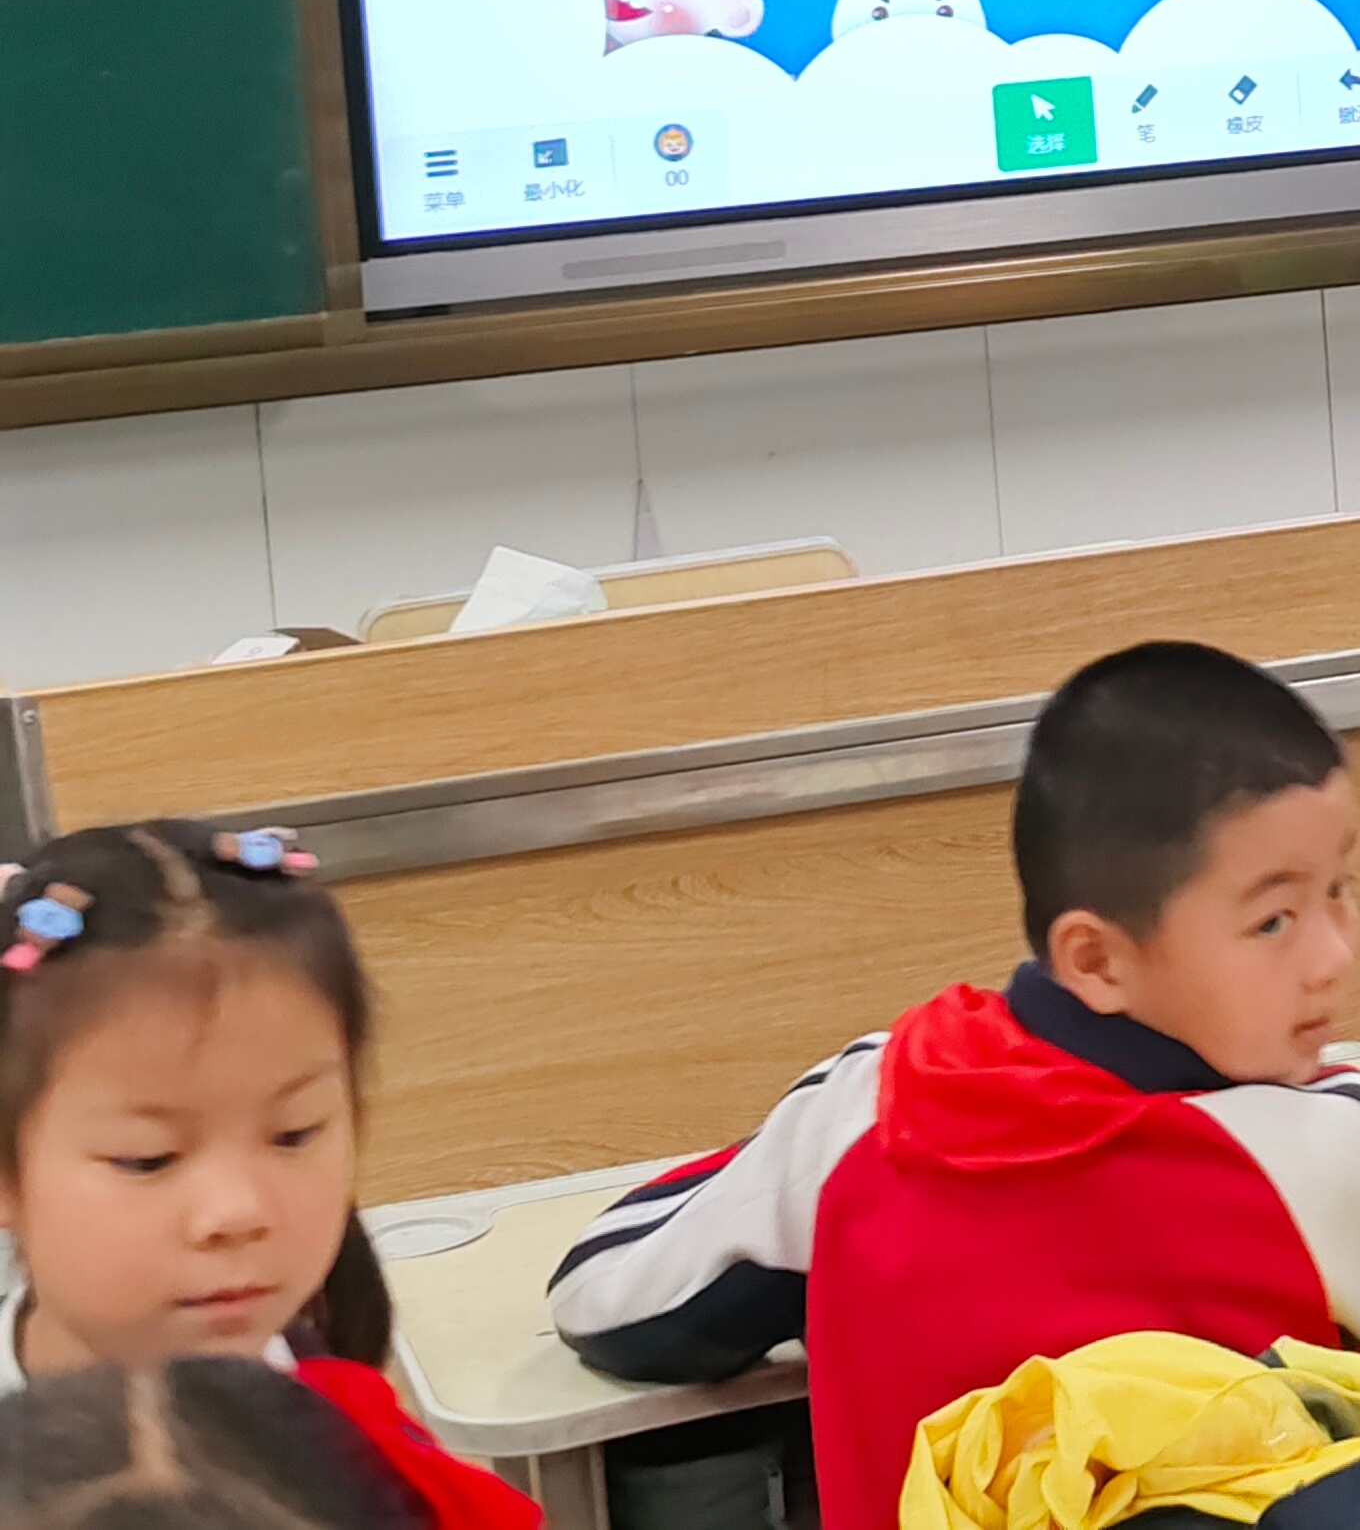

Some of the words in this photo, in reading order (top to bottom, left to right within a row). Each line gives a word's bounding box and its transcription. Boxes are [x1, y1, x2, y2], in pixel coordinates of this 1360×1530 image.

[1137, 124, 1156, 143] 笔
[1226, 116, 1264, 134] 橡皮
[1027, 133, 1066, 154] 选择
[524, 179, 586, 202] 最小化
[424, 191, 466, 212] 菜单
